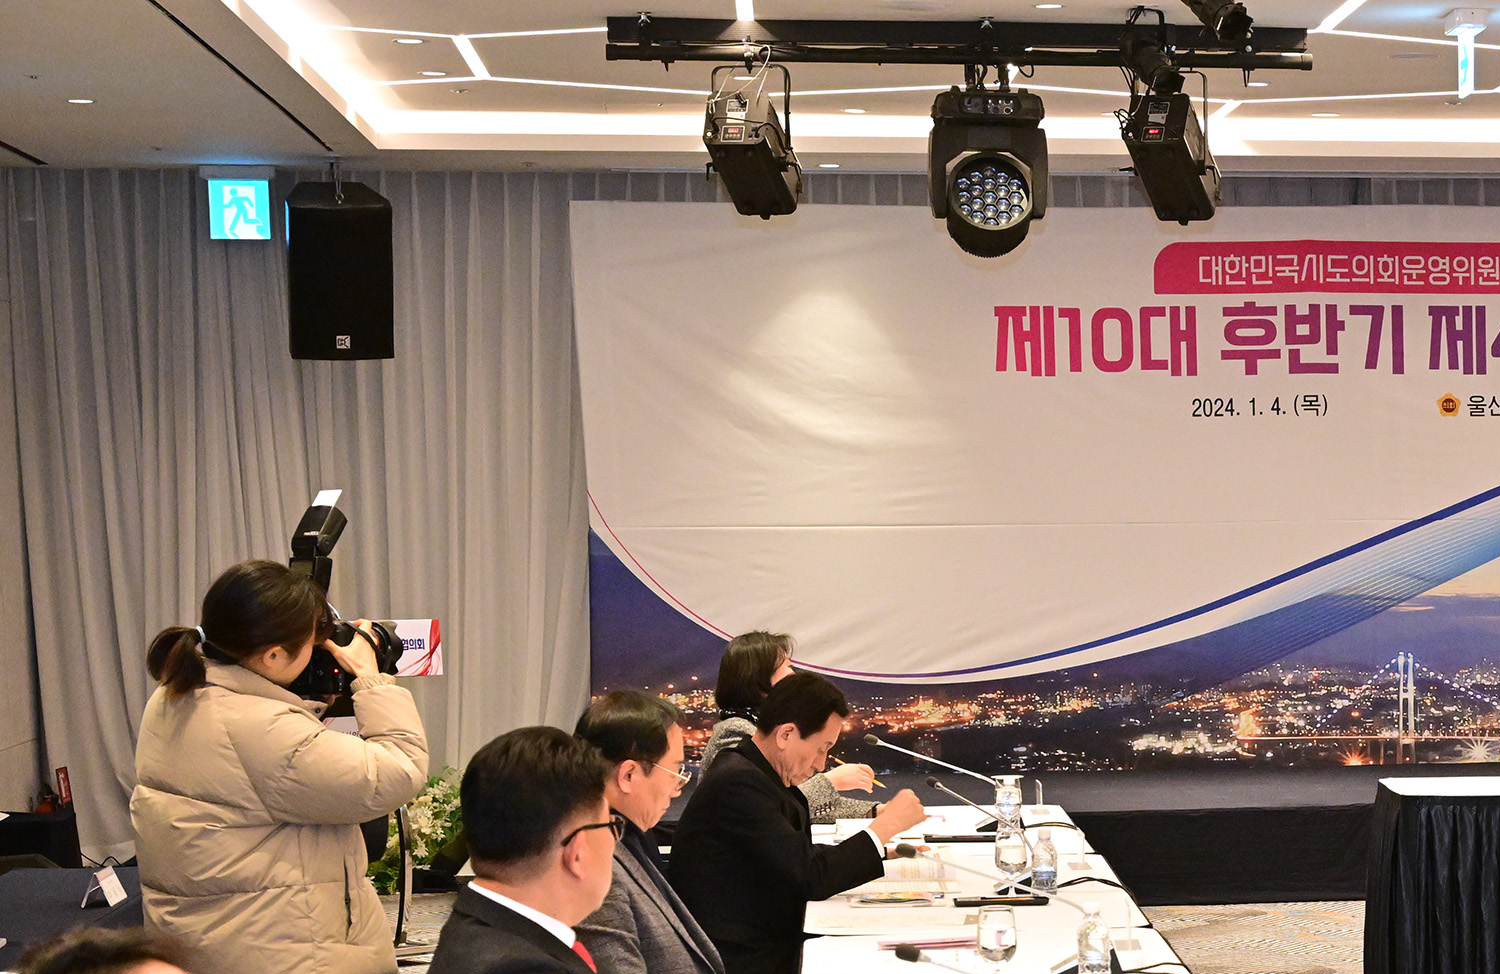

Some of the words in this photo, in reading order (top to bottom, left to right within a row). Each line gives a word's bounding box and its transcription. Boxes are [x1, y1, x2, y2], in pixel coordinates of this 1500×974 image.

[994, 305, 1198, 377] 제10대
[1220, 301, 1405, 375] 후반기
[1191, 397, 1241, 418] 2024.
[1248, 397, 1264, 417] 1.
[1270, 397, 1287, 416] 4.
[1293, 394, 1328, 417] (목)
